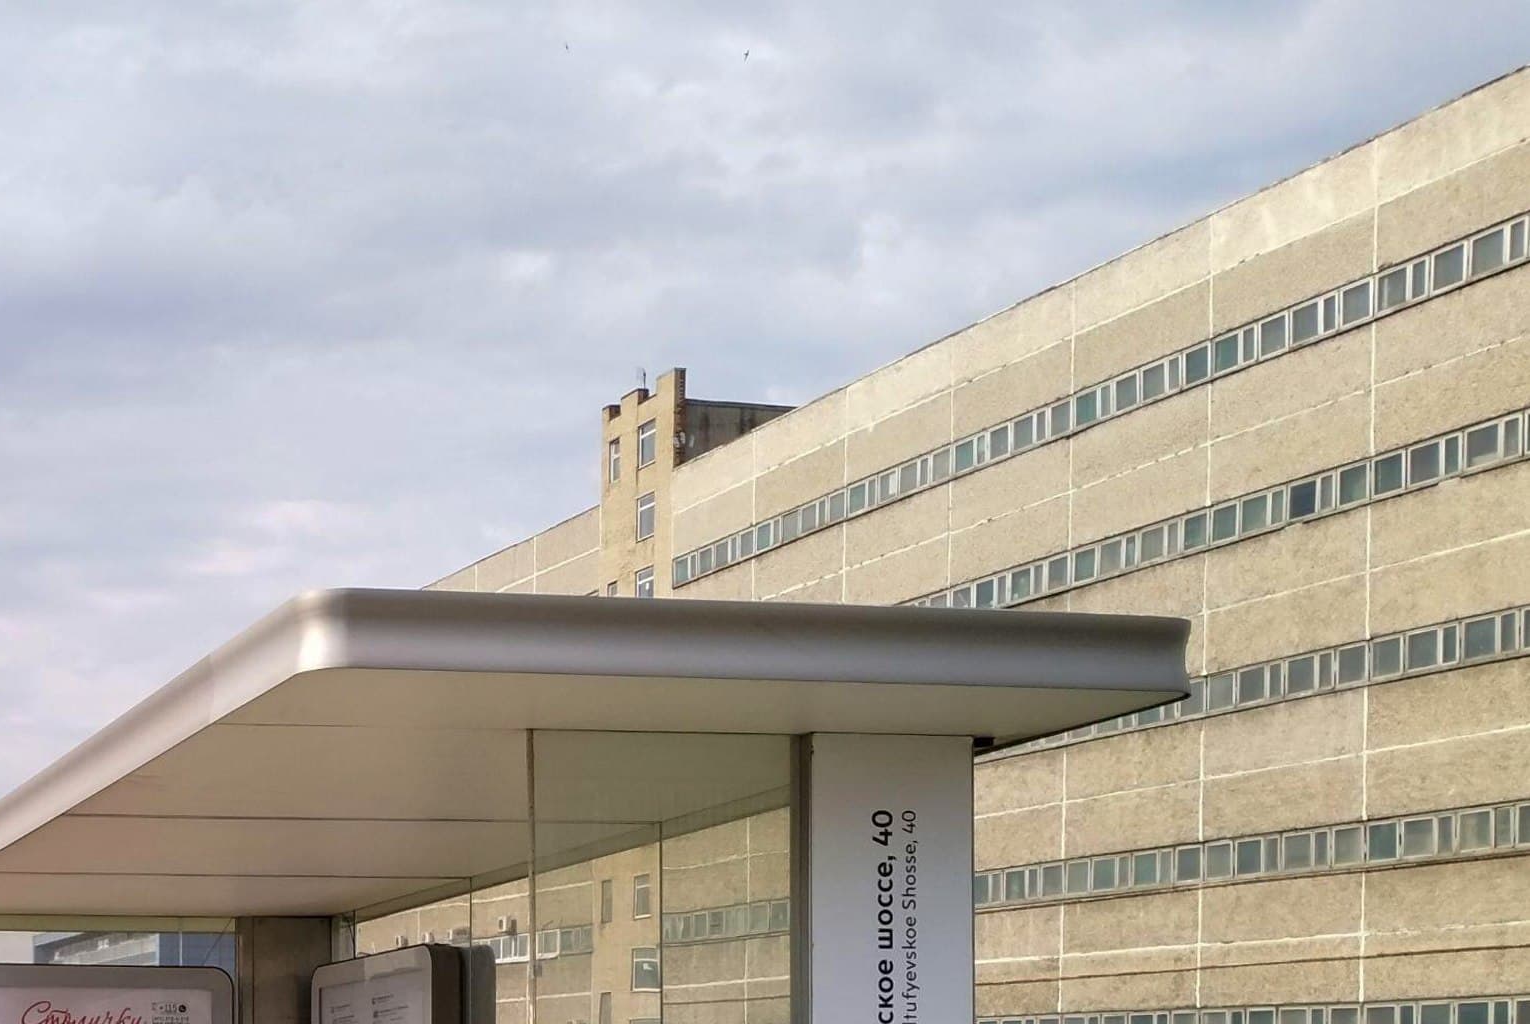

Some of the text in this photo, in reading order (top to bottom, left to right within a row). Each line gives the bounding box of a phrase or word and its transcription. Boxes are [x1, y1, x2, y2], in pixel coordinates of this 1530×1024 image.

[871, 810, 893, 846] 40
[901, 810, 916, 834] 40
[901, 840, 918, 910] Shosse,
[877, 855, 897, 949] шоссе,
